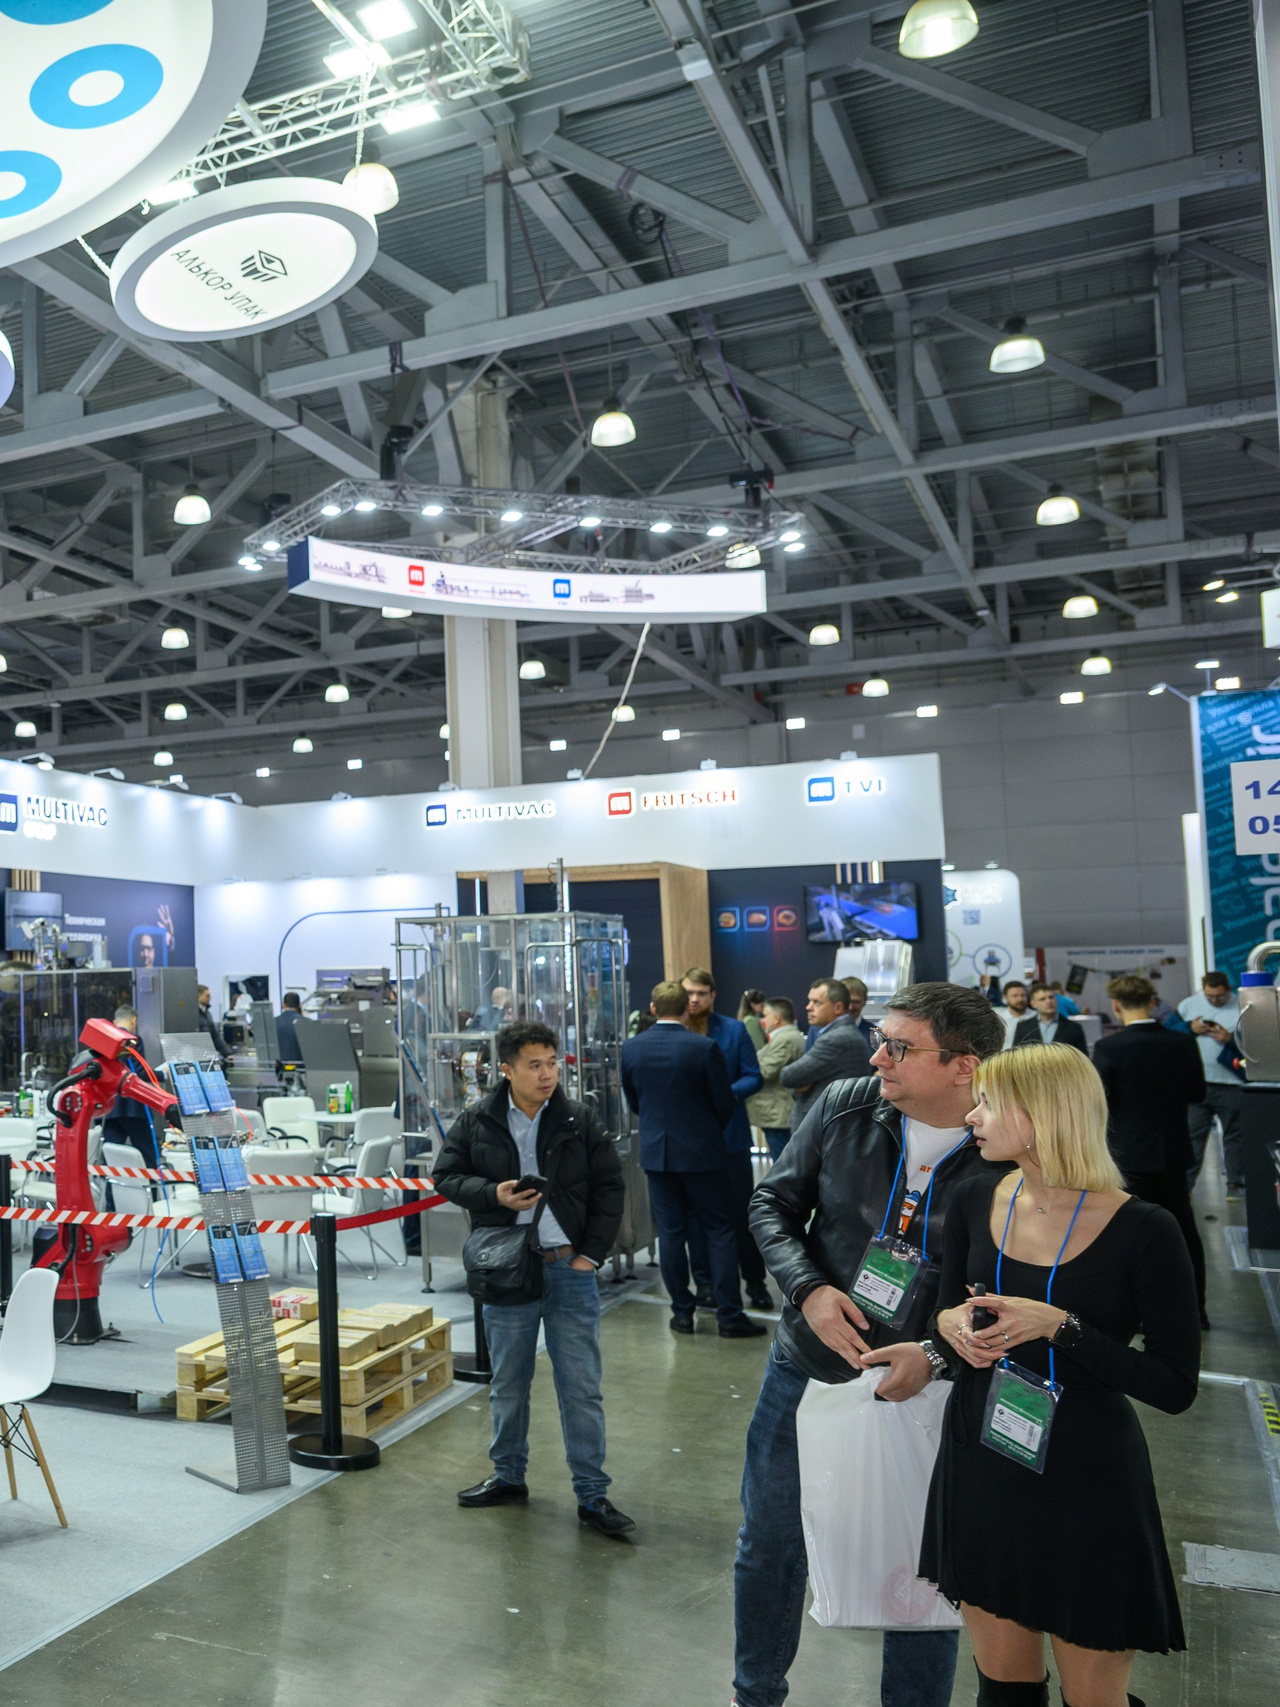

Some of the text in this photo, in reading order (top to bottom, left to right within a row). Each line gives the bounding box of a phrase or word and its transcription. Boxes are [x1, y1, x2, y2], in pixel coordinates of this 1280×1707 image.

[170, 249, 269, 320] АЛЬКОР УПАК
[643, 790, 736, 807] FRITSCH
[26, 796, 108, 826] MULTIVAC
[457, 802, 552, 820] MULTIVAC
[919, 1165, 933, 1173] ar
